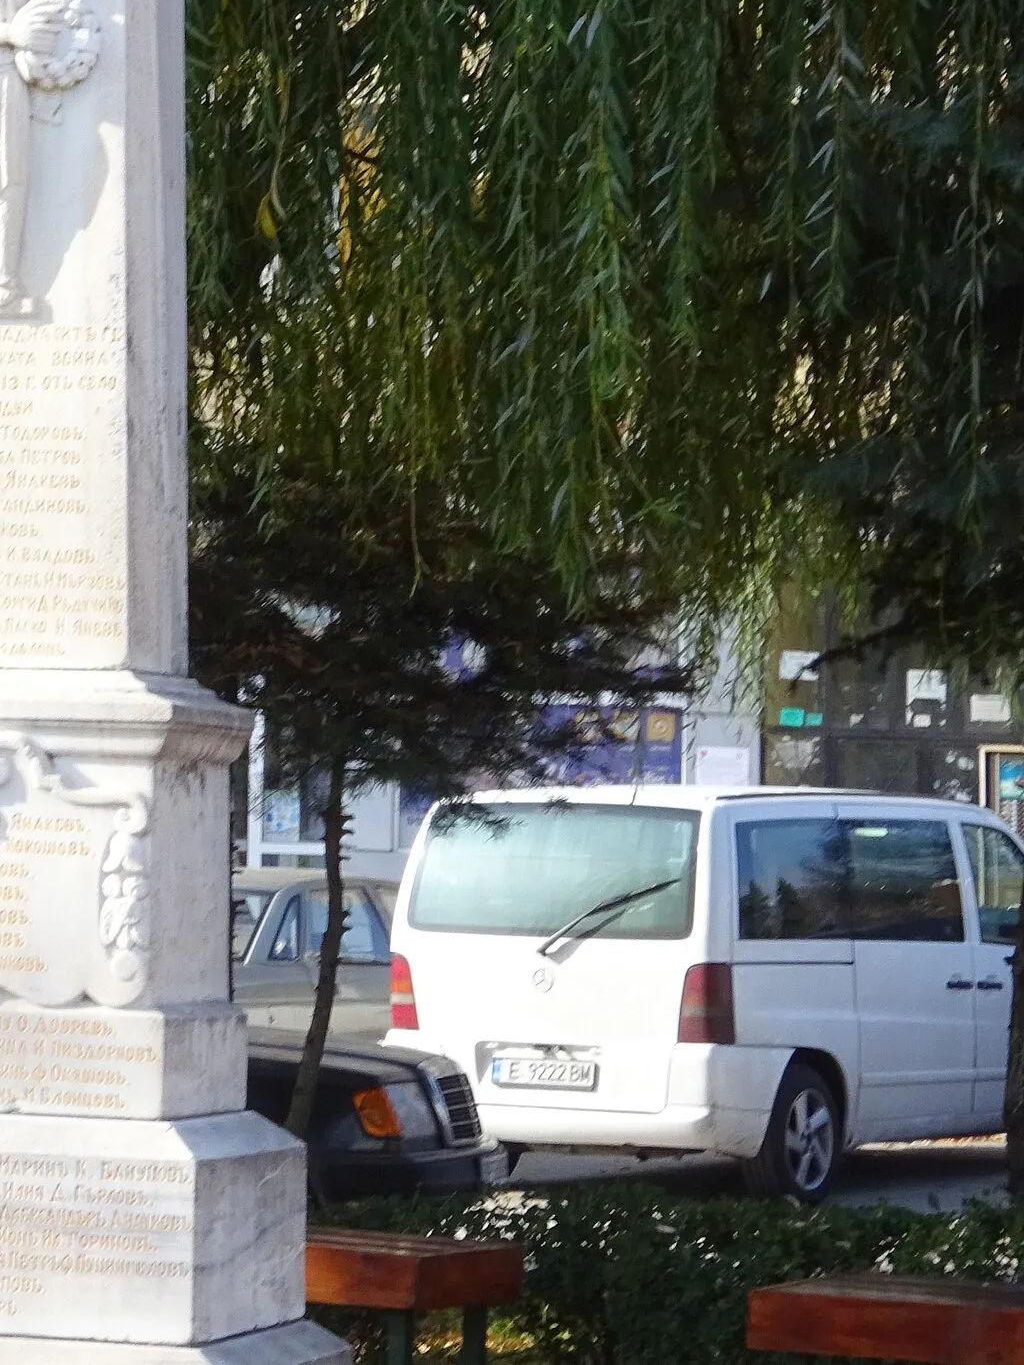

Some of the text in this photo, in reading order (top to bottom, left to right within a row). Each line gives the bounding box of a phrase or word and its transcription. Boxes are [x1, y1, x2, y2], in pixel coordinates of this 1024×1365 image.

[78, 375, 118, 392] СЕЛО
[508, 1061, 521, 1080] E
[528, 1062, 568, 1082] 9222
